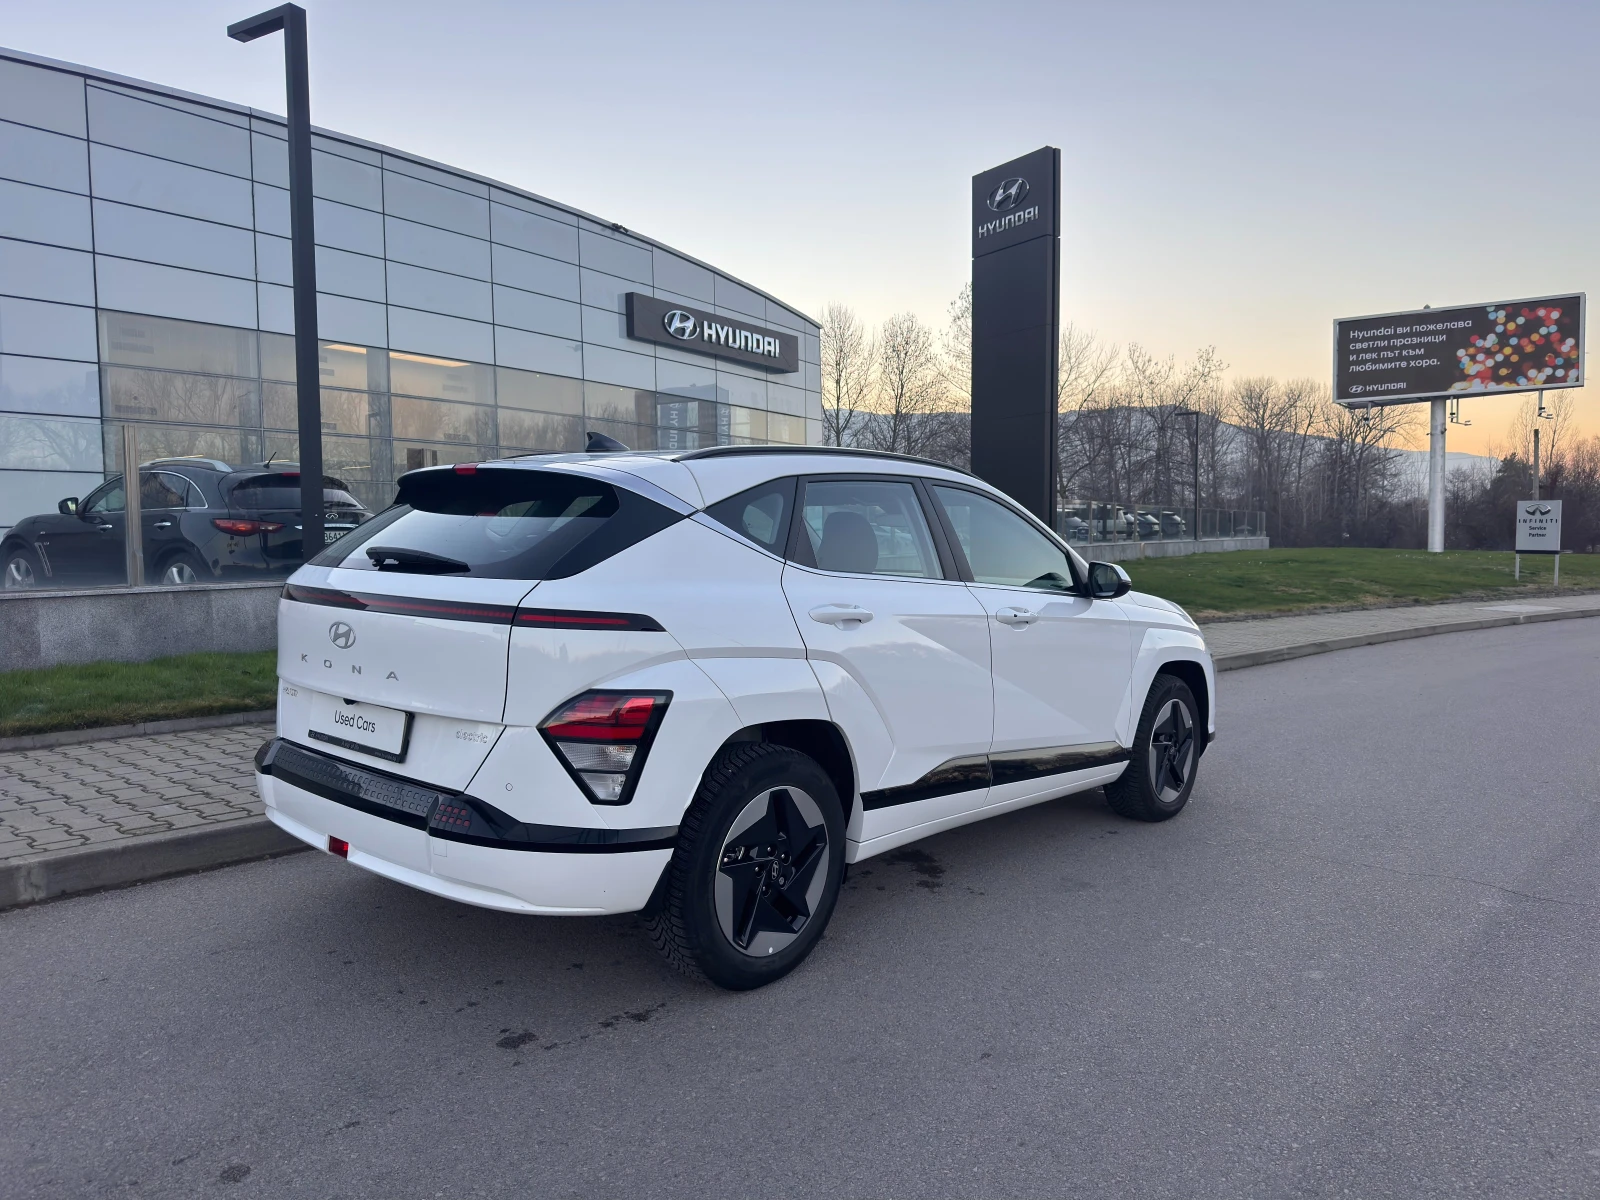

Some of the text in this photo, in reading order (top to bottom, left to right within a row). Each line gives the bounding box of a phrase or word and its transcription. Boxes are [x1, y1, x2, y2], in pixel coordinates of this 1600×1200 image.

[978, 206, 1039, 238] HYUNDAI
[703, 320, 780, 358] HYUNDAI
[1350, 320, 1472, 339] Hyundai ви пожелава
[1349, 334, 1447, 350] светли празници
[1358, 351, 1378, 361] лек
[1380, 350, 1400, 359] път
[1402, 348, 1425, 357] към
[1348, 358, 1441, 373] любимите хора.
[1366, 382, 1407, 392] HYUNDAI
[300, 653, 400, 682] KONA
[334, 709, 376, 733] Used Cars
